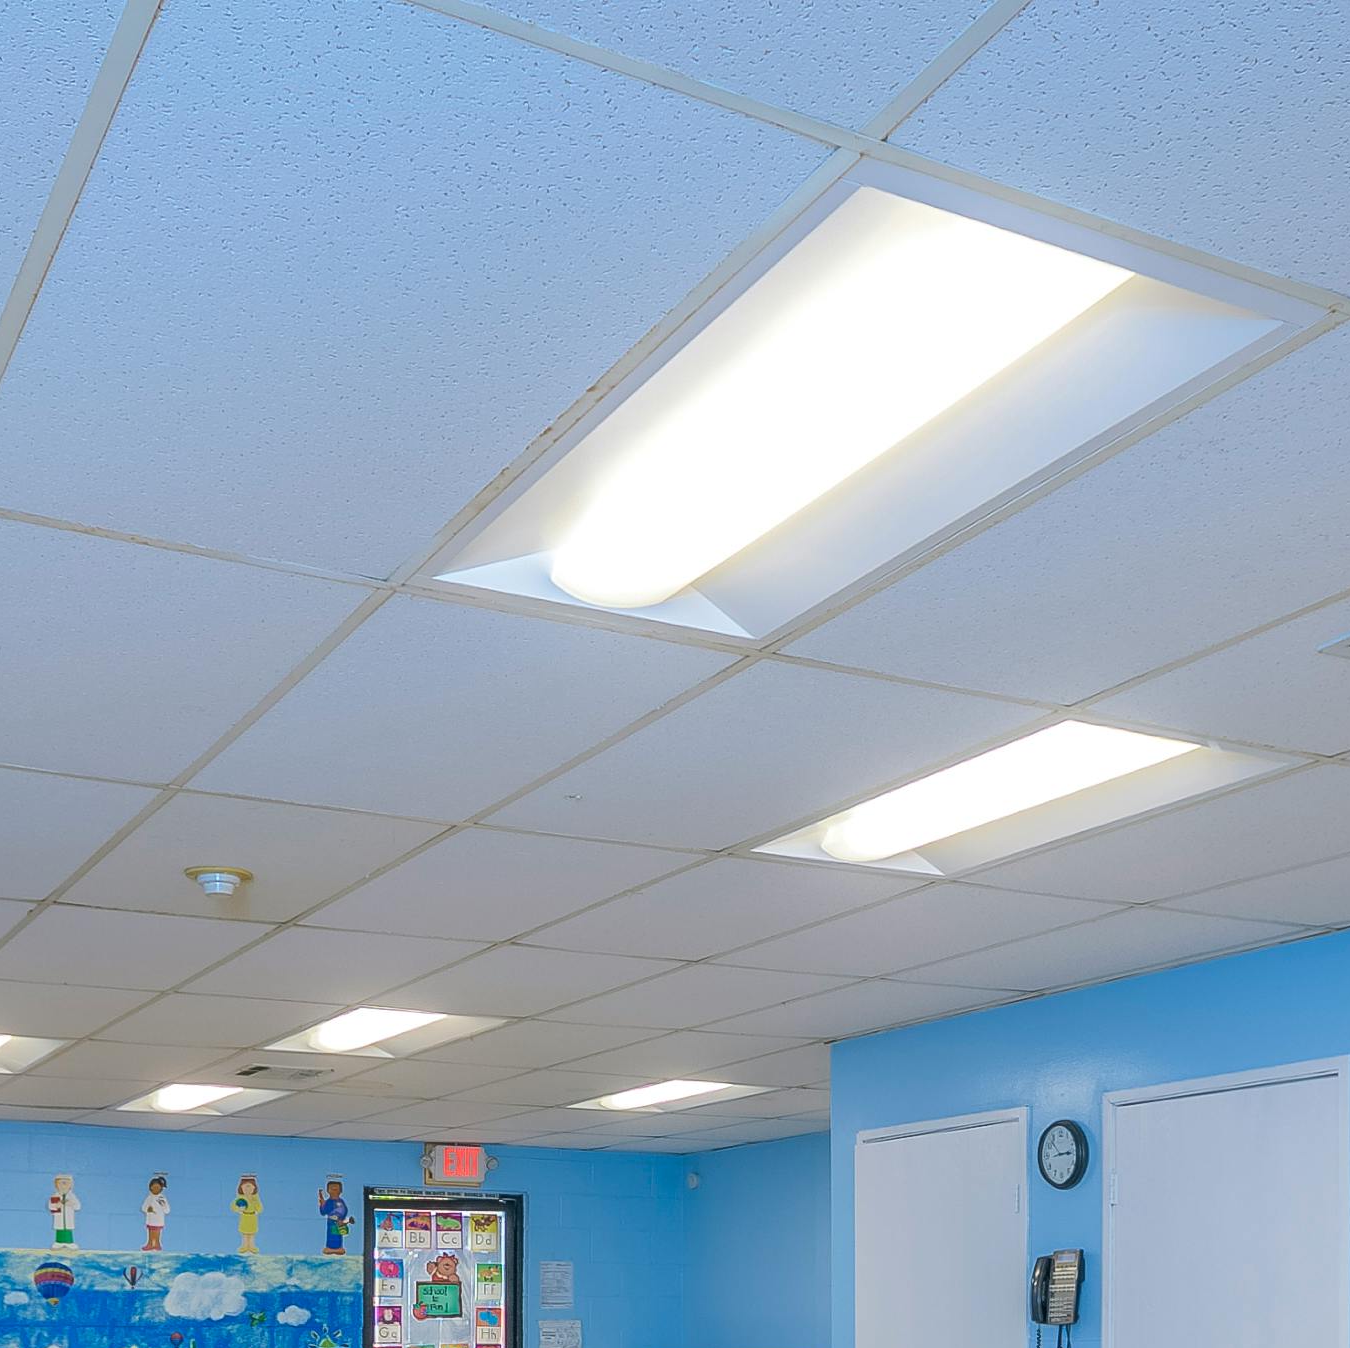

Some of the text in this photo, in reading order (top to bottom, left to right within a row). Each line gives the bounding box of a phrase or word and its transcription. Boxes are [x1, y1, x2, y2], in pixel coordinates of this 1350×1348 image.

[443, 1147, 480, 1177] EXIT
[409, 1233, 426, 1243] Bb
[441, 1233, 458, 1245] Cc
[475, 1233, 492, 1246] Dd
[480, 1327, 497, 1339] Hh
